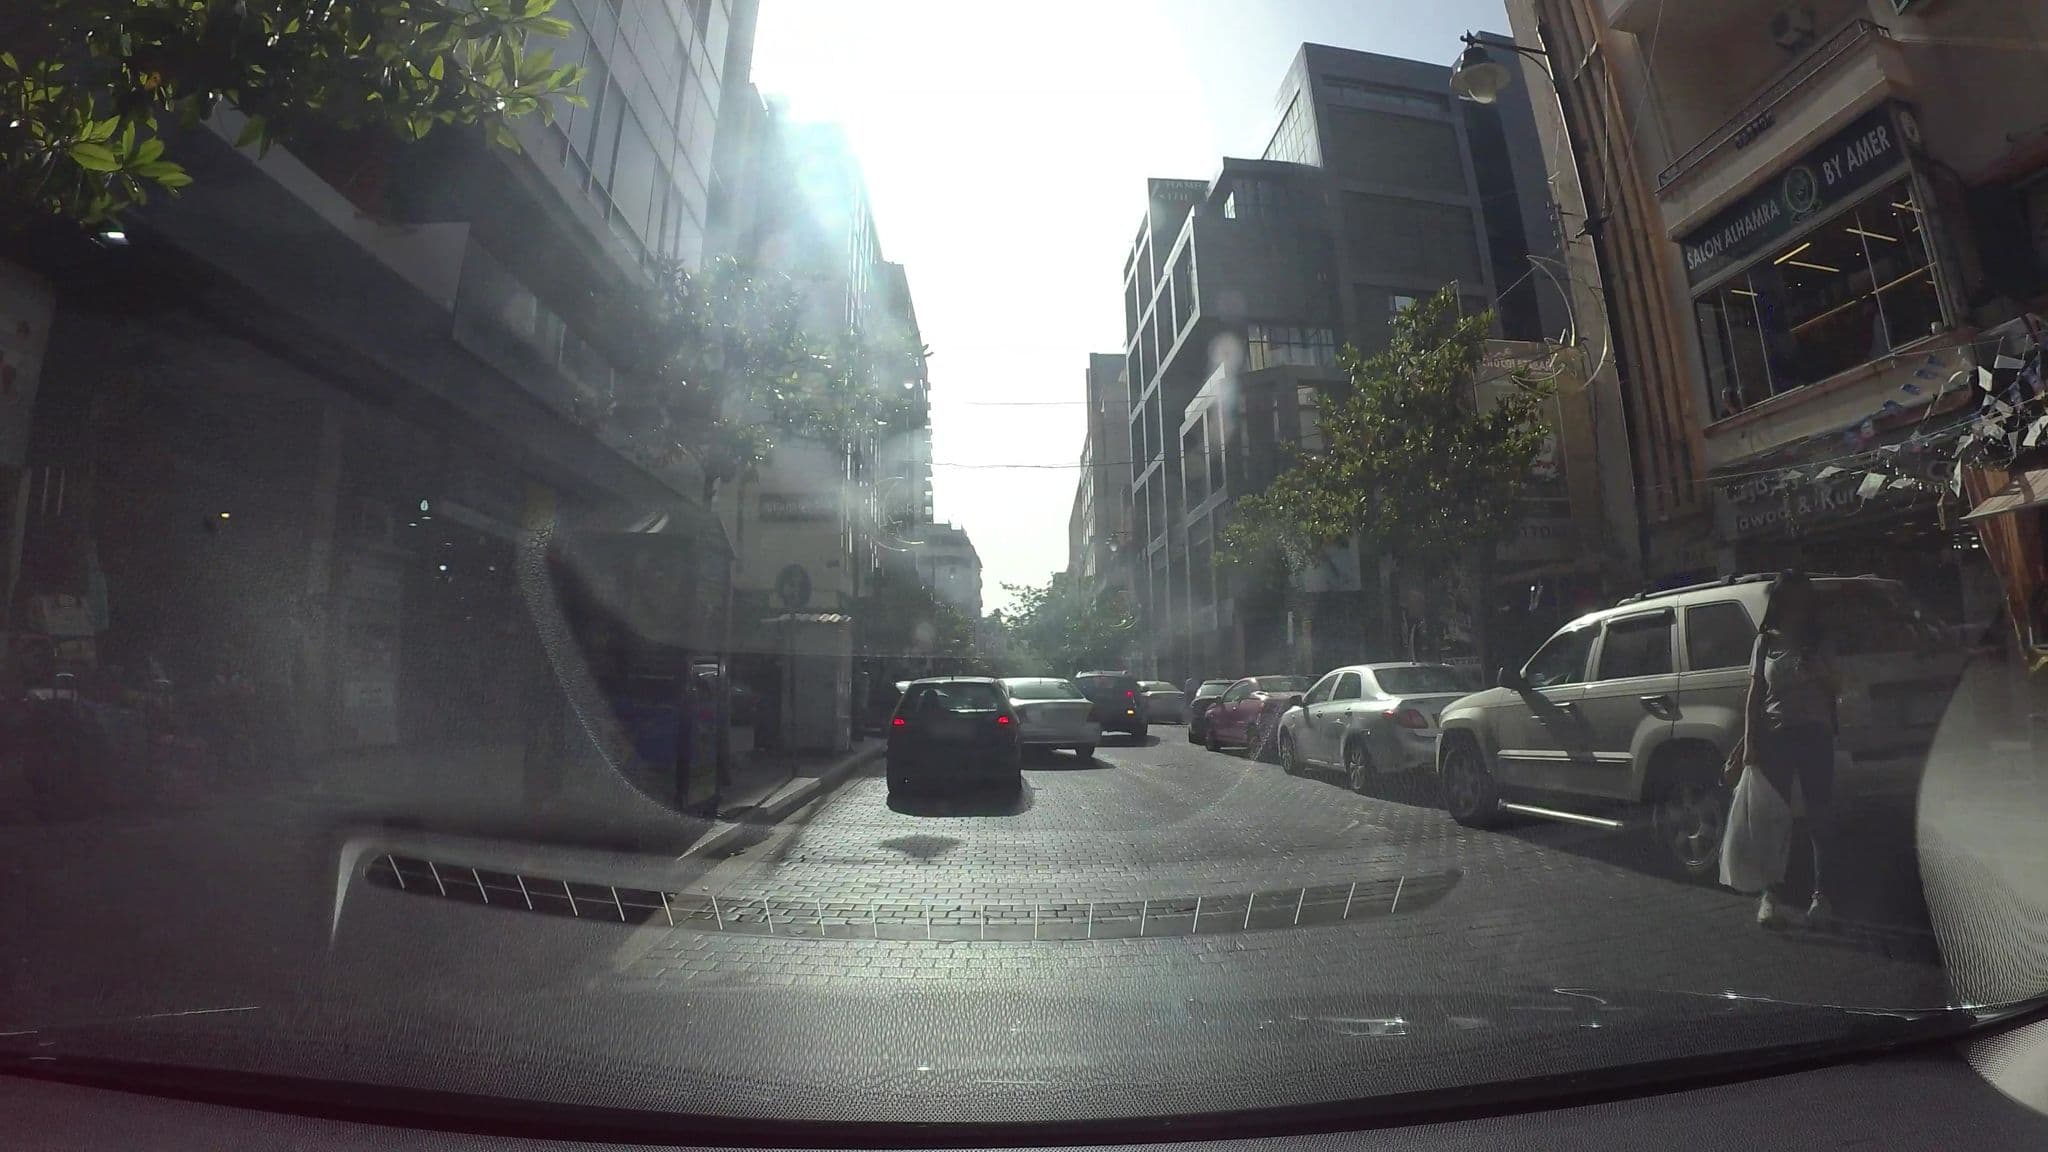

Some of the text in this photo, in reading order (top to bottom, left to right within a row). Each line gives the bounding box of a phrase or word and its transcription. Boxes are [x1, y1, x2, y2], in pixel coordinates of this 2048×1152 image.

[1686, 125, 1892, 270] SALON ALHAMRA BY AMER
